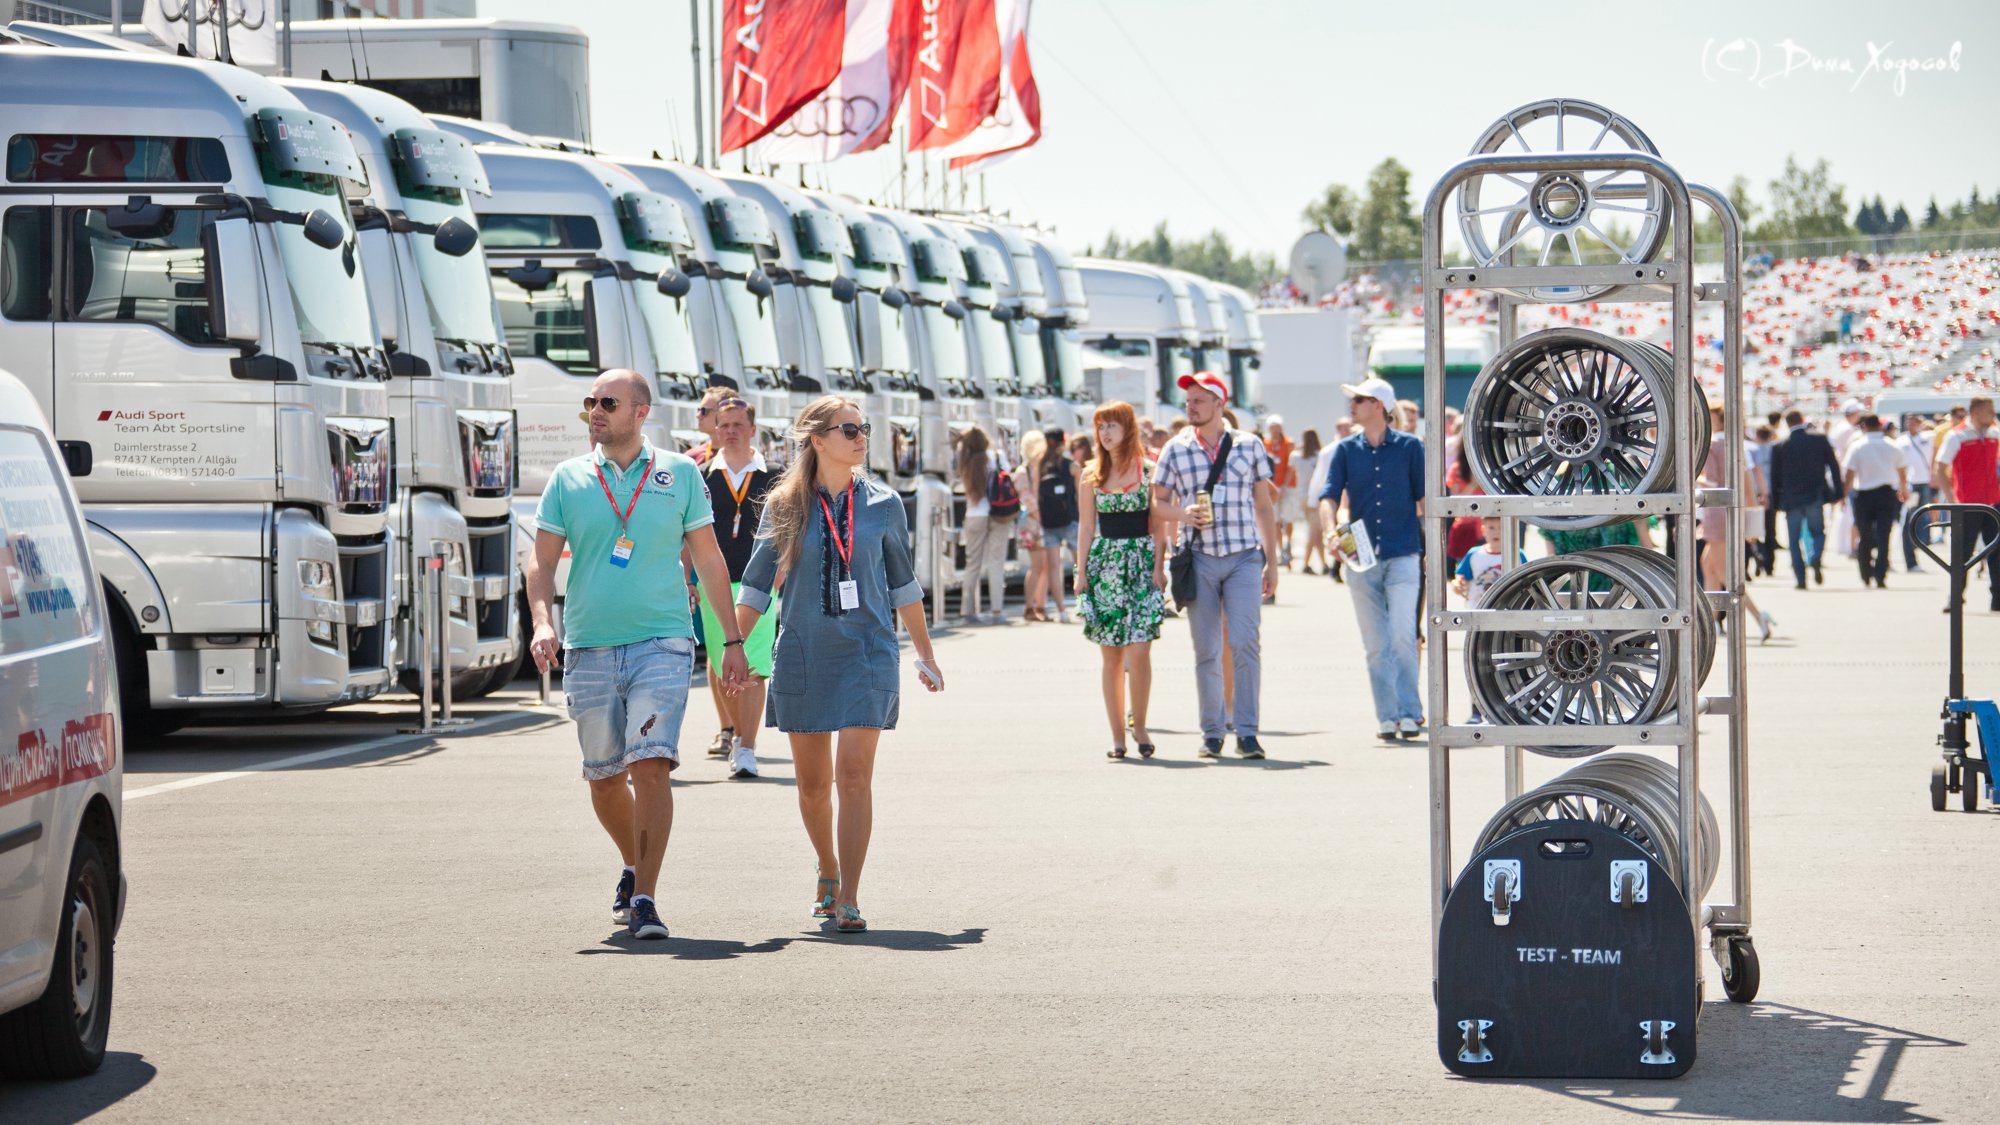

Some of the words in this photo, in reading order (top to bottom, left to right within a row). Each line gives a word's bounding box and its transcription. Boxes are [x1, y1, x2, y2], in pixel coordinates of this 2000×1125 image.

[114, 410, 145, 420] Audi
[148, 410, 186, 422] Sport
[115, 423, 149, 433] Team
[153, 423, 176, 433] Abt
[180, 423, 246, 435] Sportsline
[538, 425, 567, 434] Sport
[114, 443, 188, 452] Daimlerstrasse
[191, 443, 197, 452] 2
[114, 455, 147, 464] 87437
[150, 455, 196, 466] Kempten
[197, 455, 203, 464] /
[205, 455, 237, 467] Allgäu
[116, 468, 150, 477] Telefon
[154, 467, 189, 478] (0831)
[191, 467, 236, 477] 57140-0
[1516, 947, 1557, 963] TEST
[1571, 948, 1622, 965] TEAM
